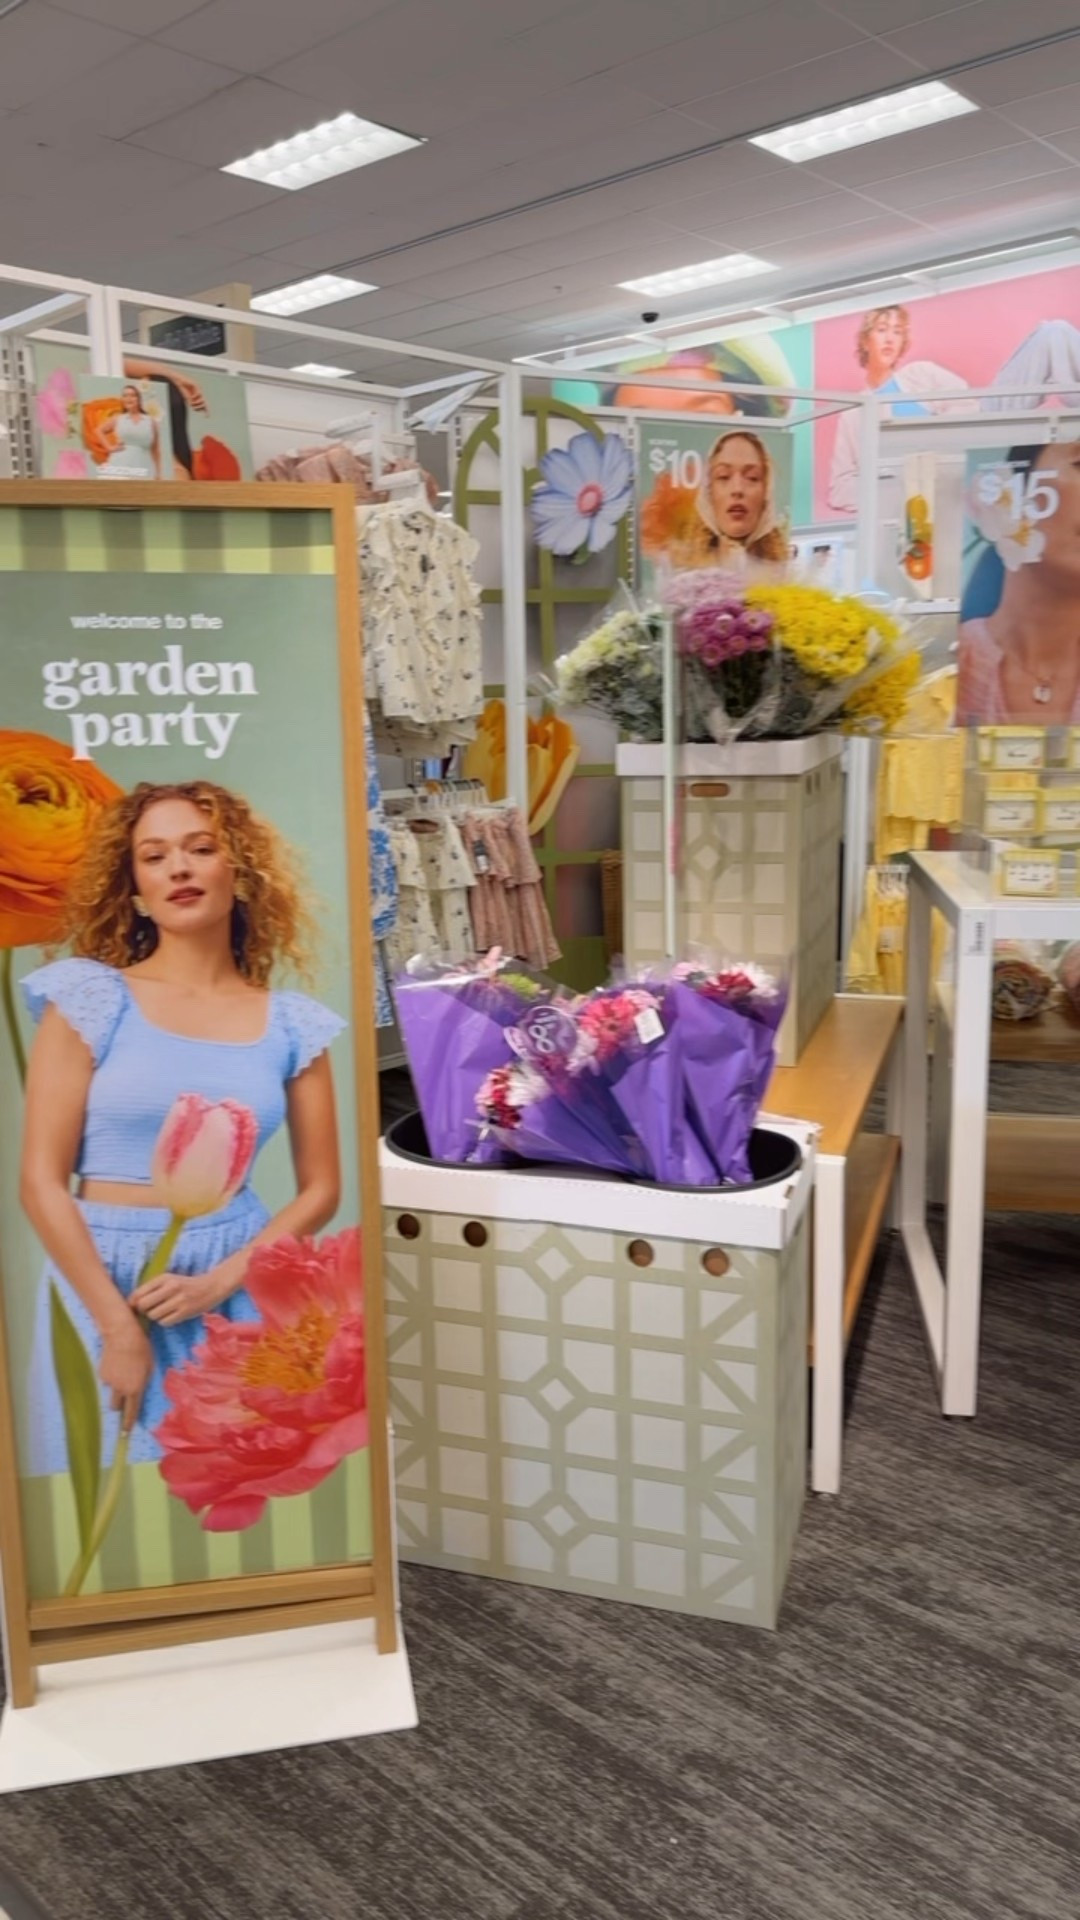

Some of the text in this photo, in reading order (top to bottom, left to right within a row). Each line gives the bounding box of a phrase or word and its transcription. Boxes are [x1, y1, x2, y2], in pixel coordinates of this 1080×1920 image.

[648, 447, 703, 490] $10
[978, 469, 1060, 521] $15
[70, 613, 224, 629] welcome to the
[42, 644, 259, 710] garden
[67, 701, 242, 760] party
